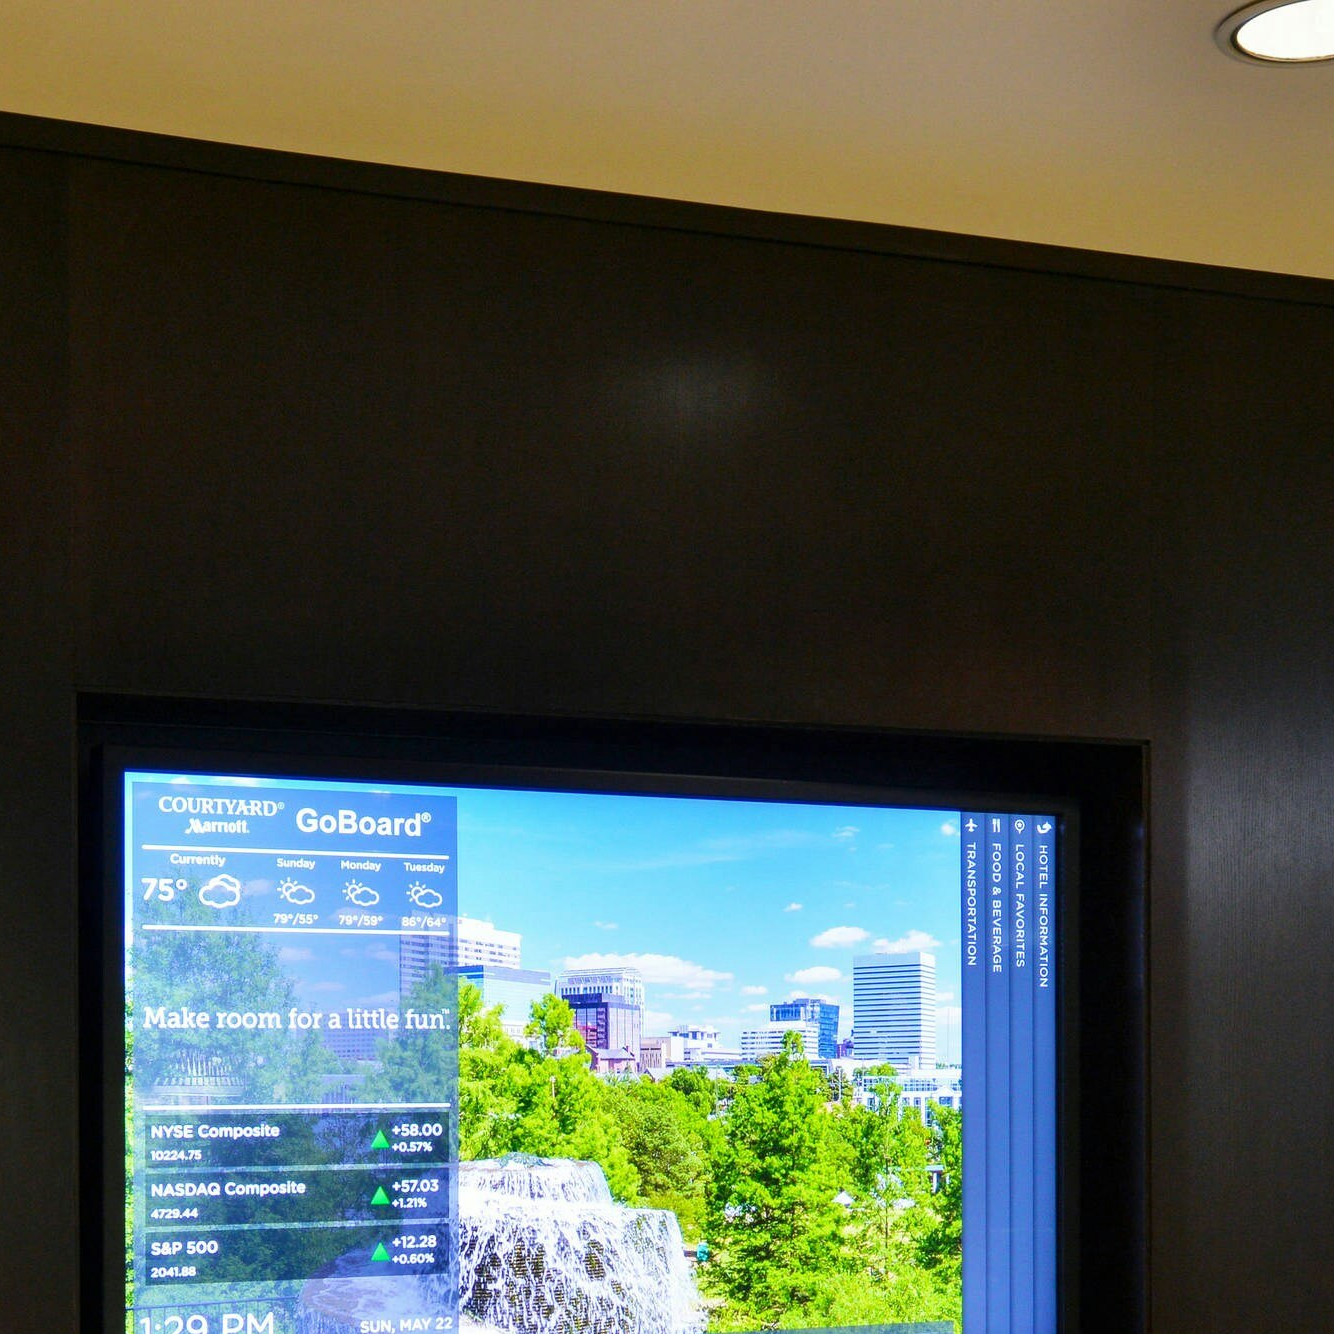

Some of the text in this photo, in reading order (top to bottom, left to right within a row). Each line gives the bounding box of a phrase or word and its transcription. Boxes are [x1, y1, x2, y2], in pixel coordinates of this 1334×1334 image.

[170, 854, 226, 867] Currently
[276, 858, 316, 870] Sunday
[341, 860, 381, 872] Monday
[403, 863, 445, 874] Tuesday
[967, 842, 976, 965] TRANSPORTATION
[992, 843, 1002, 972] FOOD & BEVERAGE
[1016, 844, 1025, 967] LOCAL FAVORITES
[1039, 845, 1048, 987] HOTEL INFORMATION
[143, 1006, 209, 1029] Make
[216, 1011, 282, 1029] room
[288, 1008, 322, 1029] for
[328, 1012, 341, 1029] a
[347, 1009, 399, 1029] little
[151, 1124, 280, 1140] NYSE Composite
[392, 1124, 442, 1137] +58.00
[392, 1142, 432, 1152] +0.57%
[151, 1150, 202, 1160] 10224.75
[151, 1181, 306, 1197] NASDAQ Composite
[392, 1179, 439, 1192] +57.03
[392, 1198, 427, 1208] +1.21%
[151, 1208, 198, 1219] 4729.44
[392, 1235, 437, 1248] +12.28
[151, 1241, 218, 1256] S&P 500
[392, 1254, 434, 1264] +0.60%
[360, 1317, 453, 1334] SUN, MAY 22
